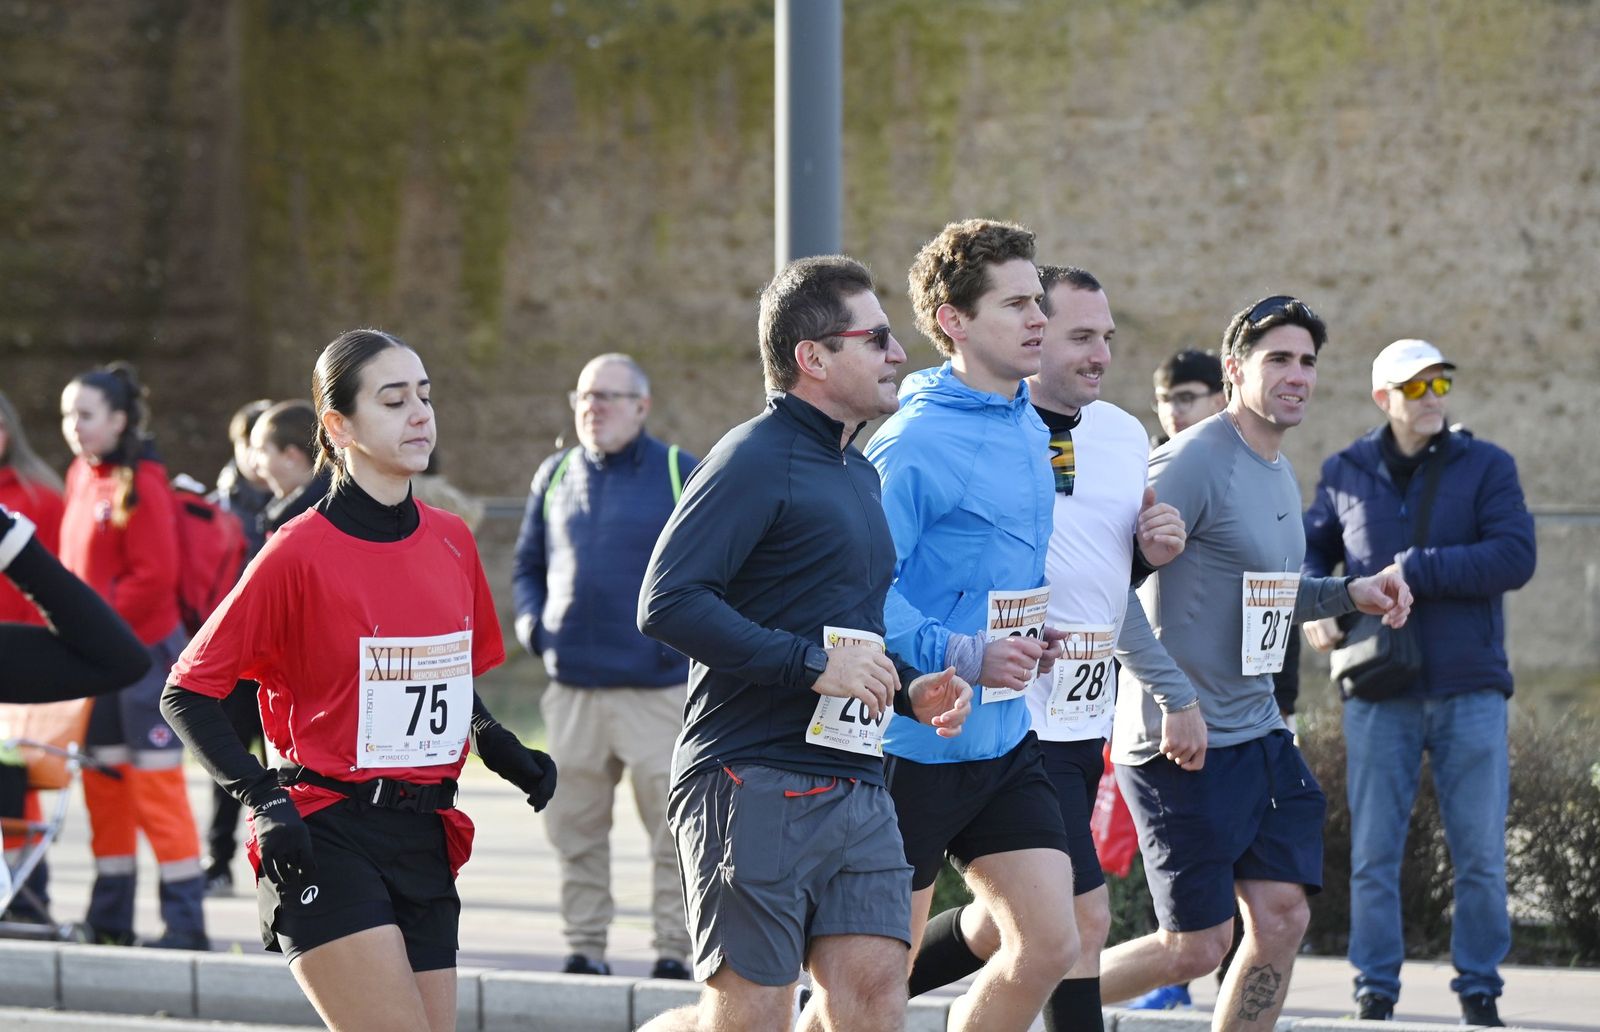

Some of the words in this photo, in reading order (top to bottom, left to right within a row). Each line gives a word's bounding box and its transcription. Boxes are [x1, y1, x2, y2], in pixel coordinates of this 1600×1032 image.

[1248, 580, 1277, 607] XLII
[993, 598, 1028, 629] XLII
[1260, 609, 1293, 651] 281
[368, 647, 414, 681] XLII
[405, 683, 448, 736] 75
[262, 798, 287, 811] KIPRUN
